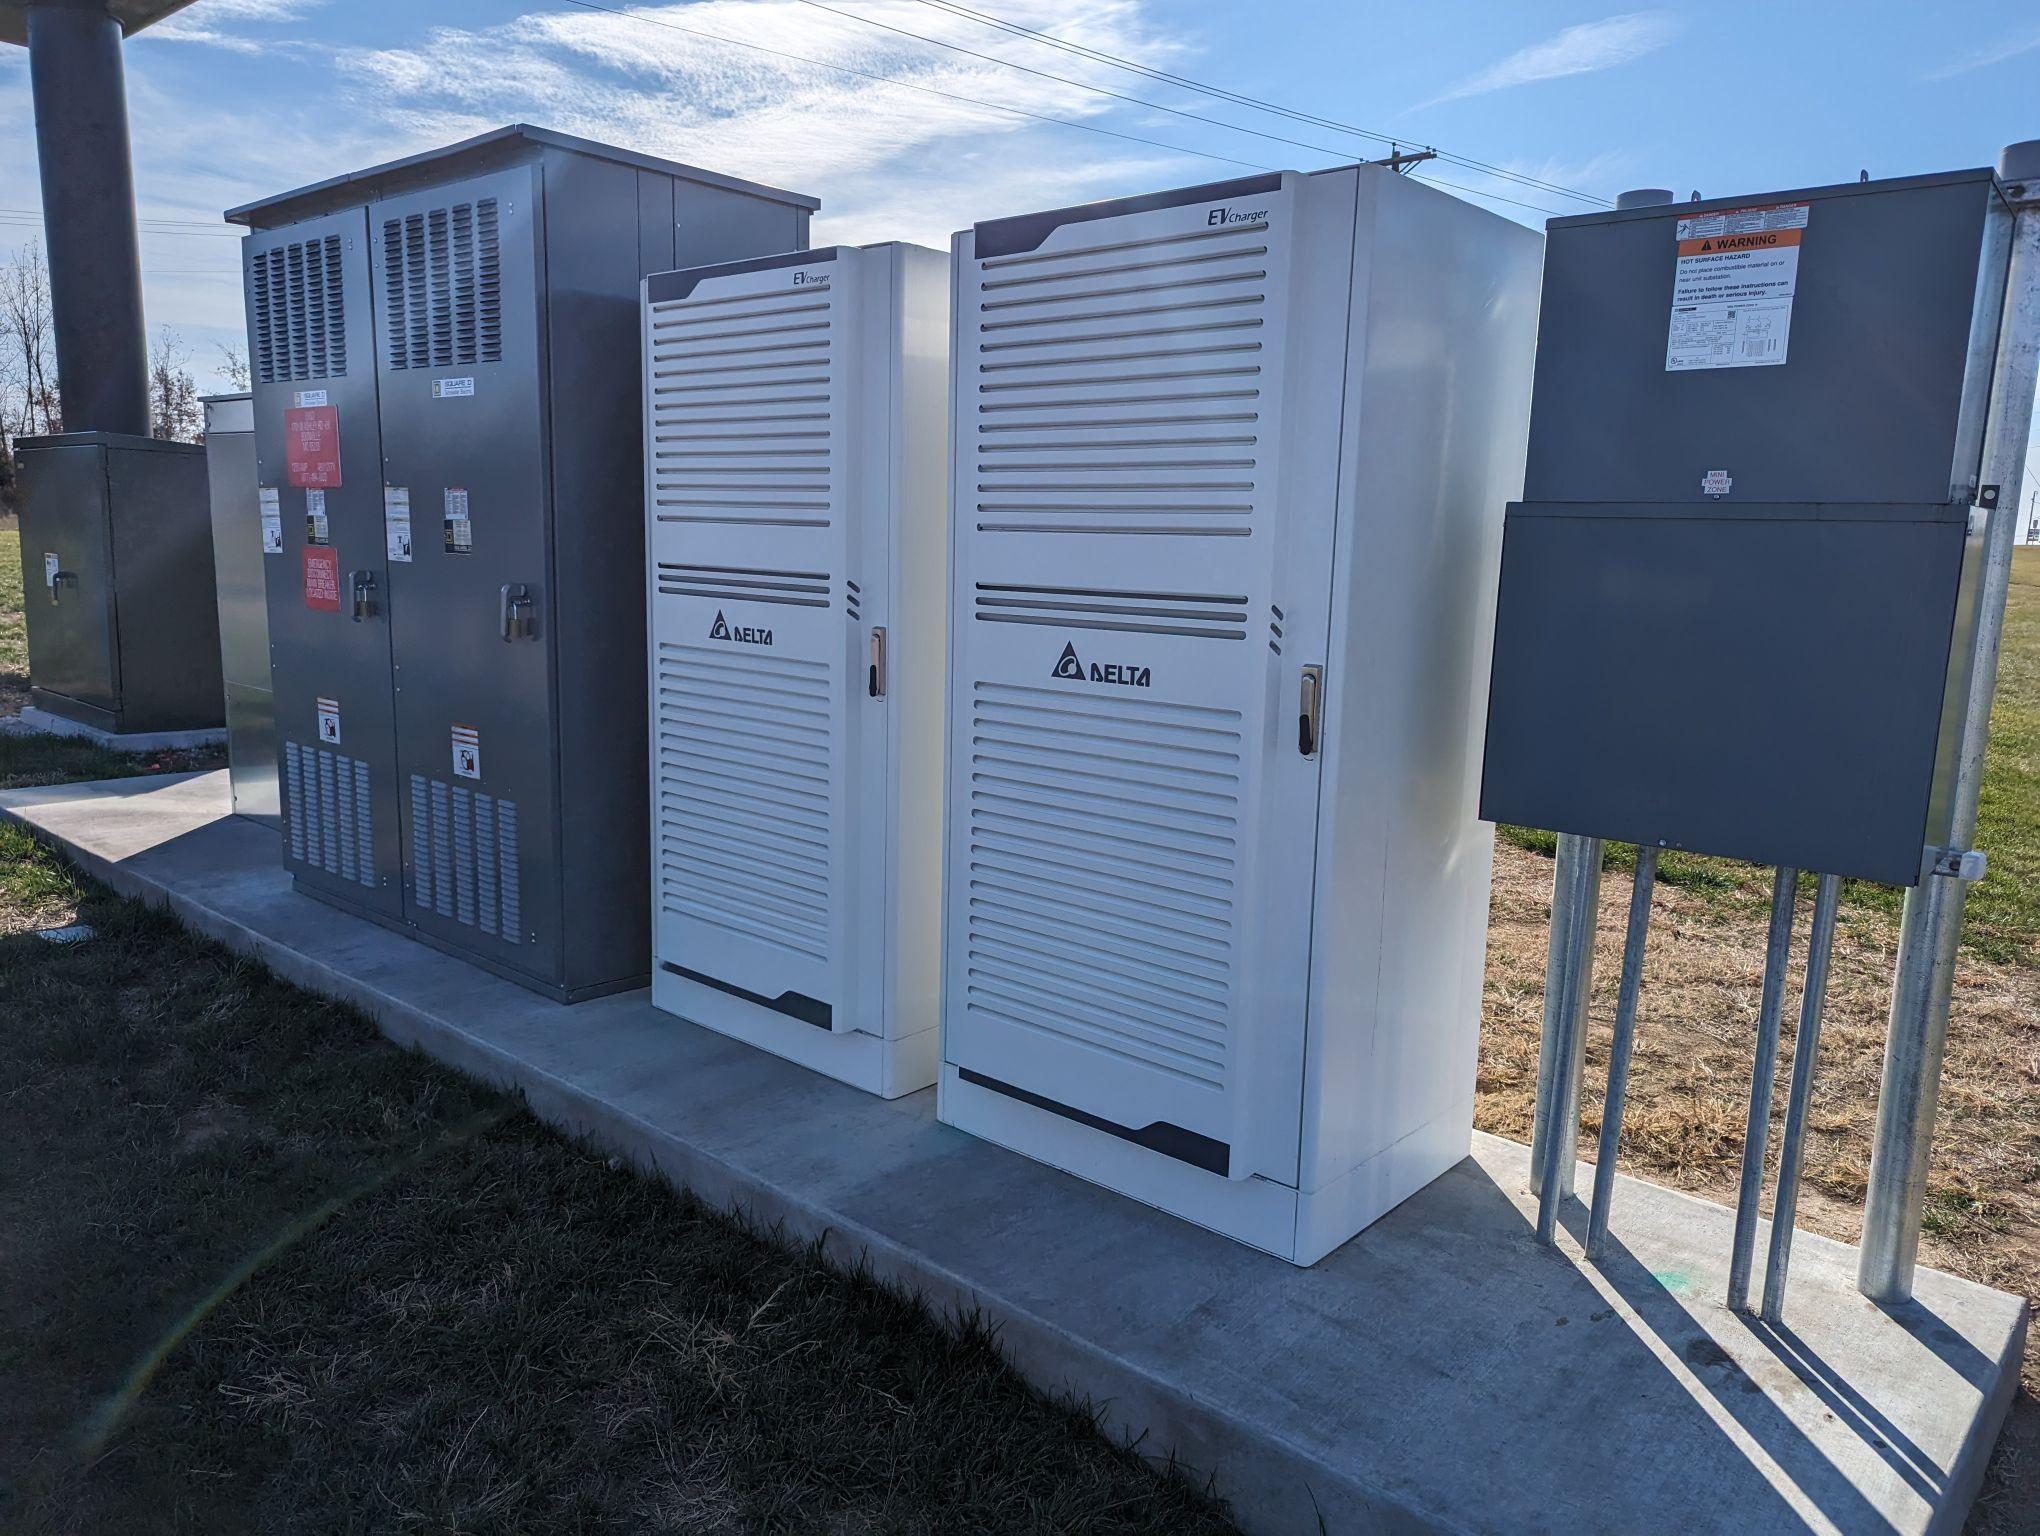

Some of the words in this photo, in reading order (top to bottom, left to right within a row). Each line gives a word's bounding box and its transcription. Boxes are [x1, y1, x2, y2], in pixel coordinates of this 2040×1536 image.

[1716, 234, 1777, 250] WARNING
[1694, 255, 1724, 264] SURFACE
[1724, 253, 1751, 261] HAZARD
[1698, 267, 1713, 275] place
[1713, 263, 1747, 272] combustible
[1747, 260, 1770, 269] material
[1677, 287, 1697, 295] Failure
[1705, 285, 1723, 293] follow
[1740, 281, 1776, 290] instructions
[1700, 293, 1717, 301] death
[1725, 291, 1747, 299] serious
[1748, 289, 1767, 297] injury.
[1710, 471, 1725, 479] MINI
[734, 625, 773, 646] DELTA
[1090, 662, 1151, 688] DELTA
